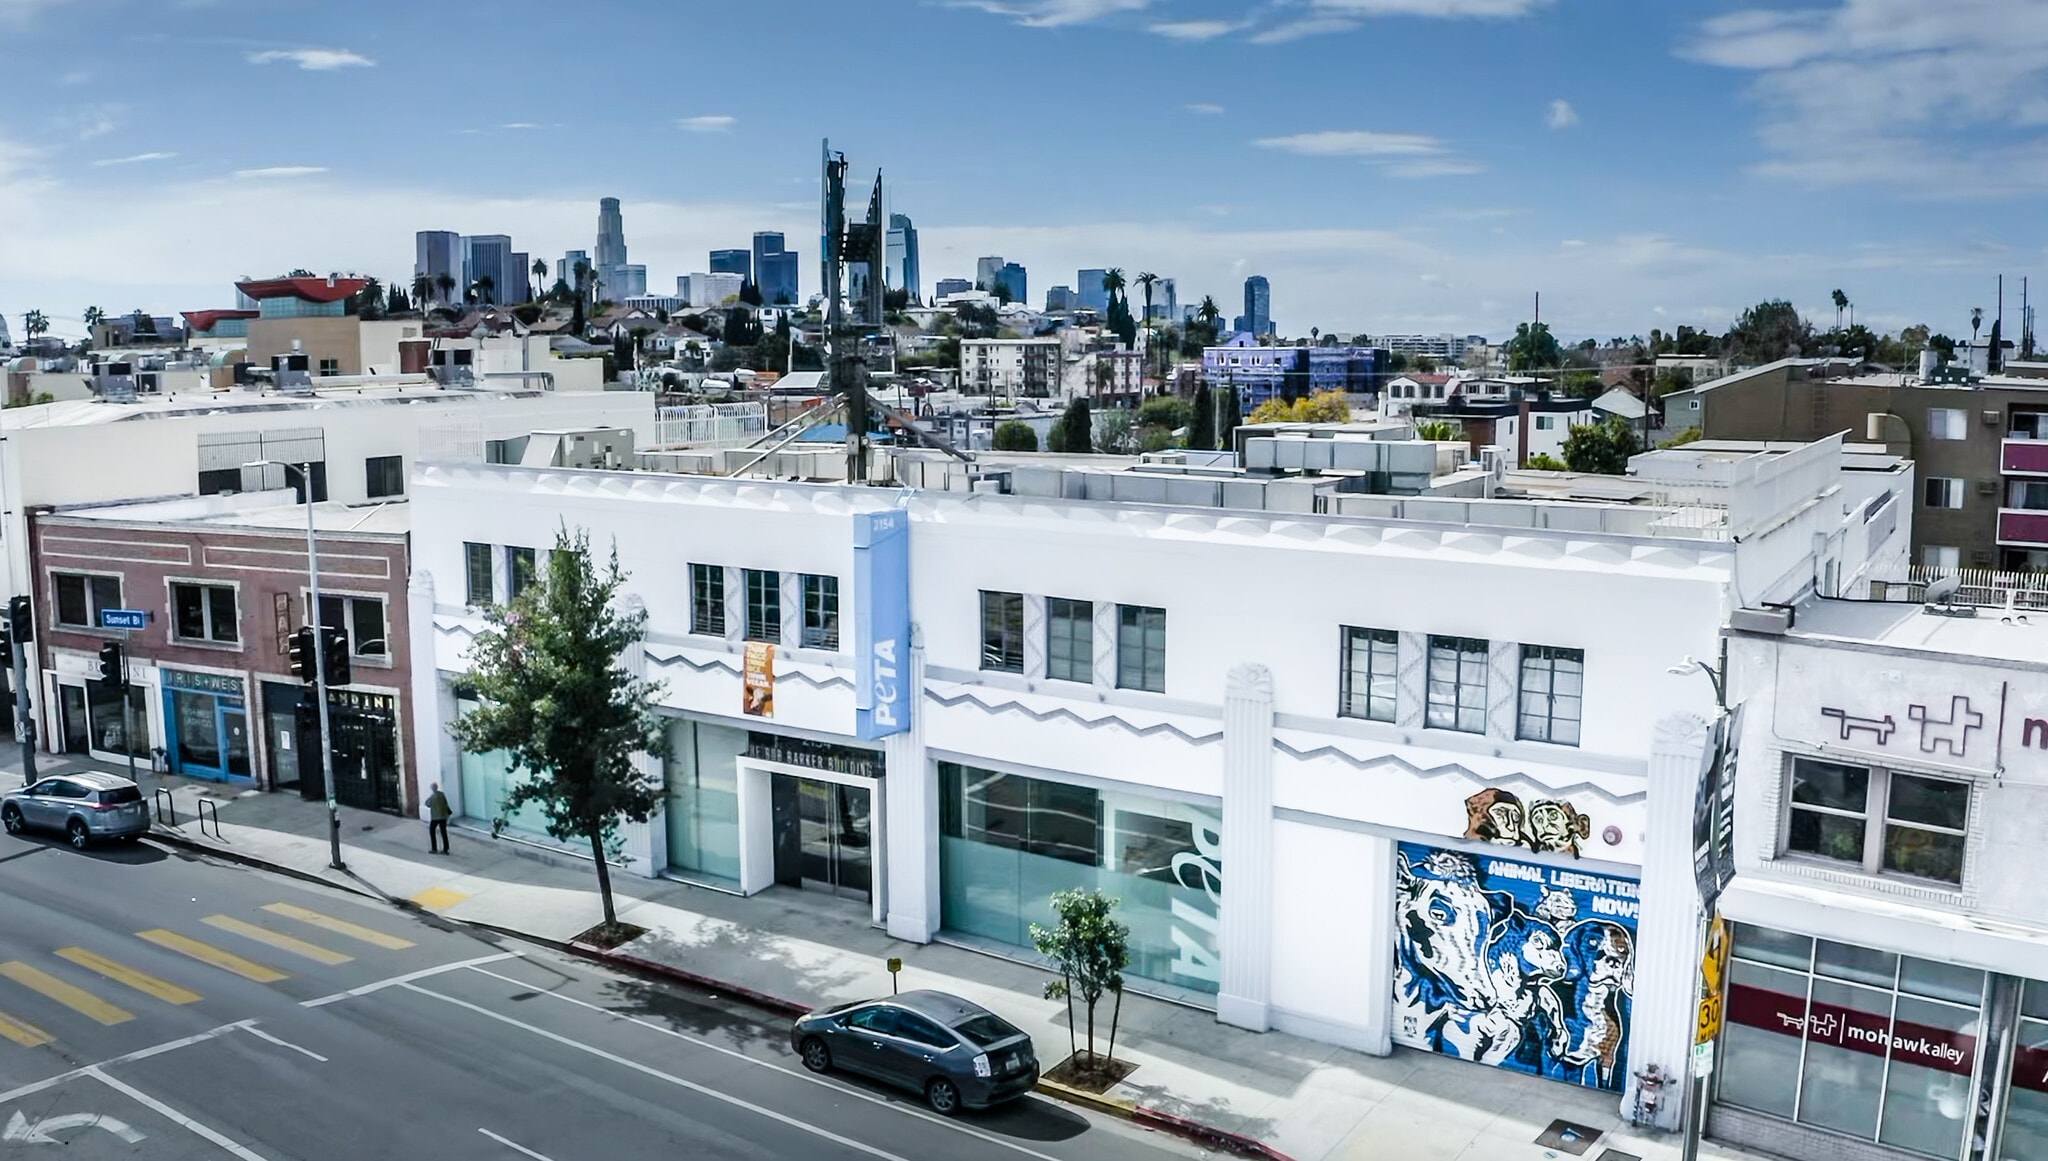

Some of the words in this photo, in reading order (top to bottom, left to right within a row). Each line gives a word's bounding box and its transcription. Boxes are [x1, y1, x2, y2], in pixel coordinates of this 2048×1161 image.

[873, 517, 894, 531] 2154
[106, 614, 130, 625] Sunset
[328, 692, 393, 710] ANDINI
[787, 750, 823, 769] BARKER
[828, 756, 873, 778] BUILDING
[1488, 860, 1546, 884] ANIMAL
[1551, 870, 1641, 899] LIBERATION
[1592, 895, 1639, 919] NOW!
[1700, 999, 1719, 1029] 30
